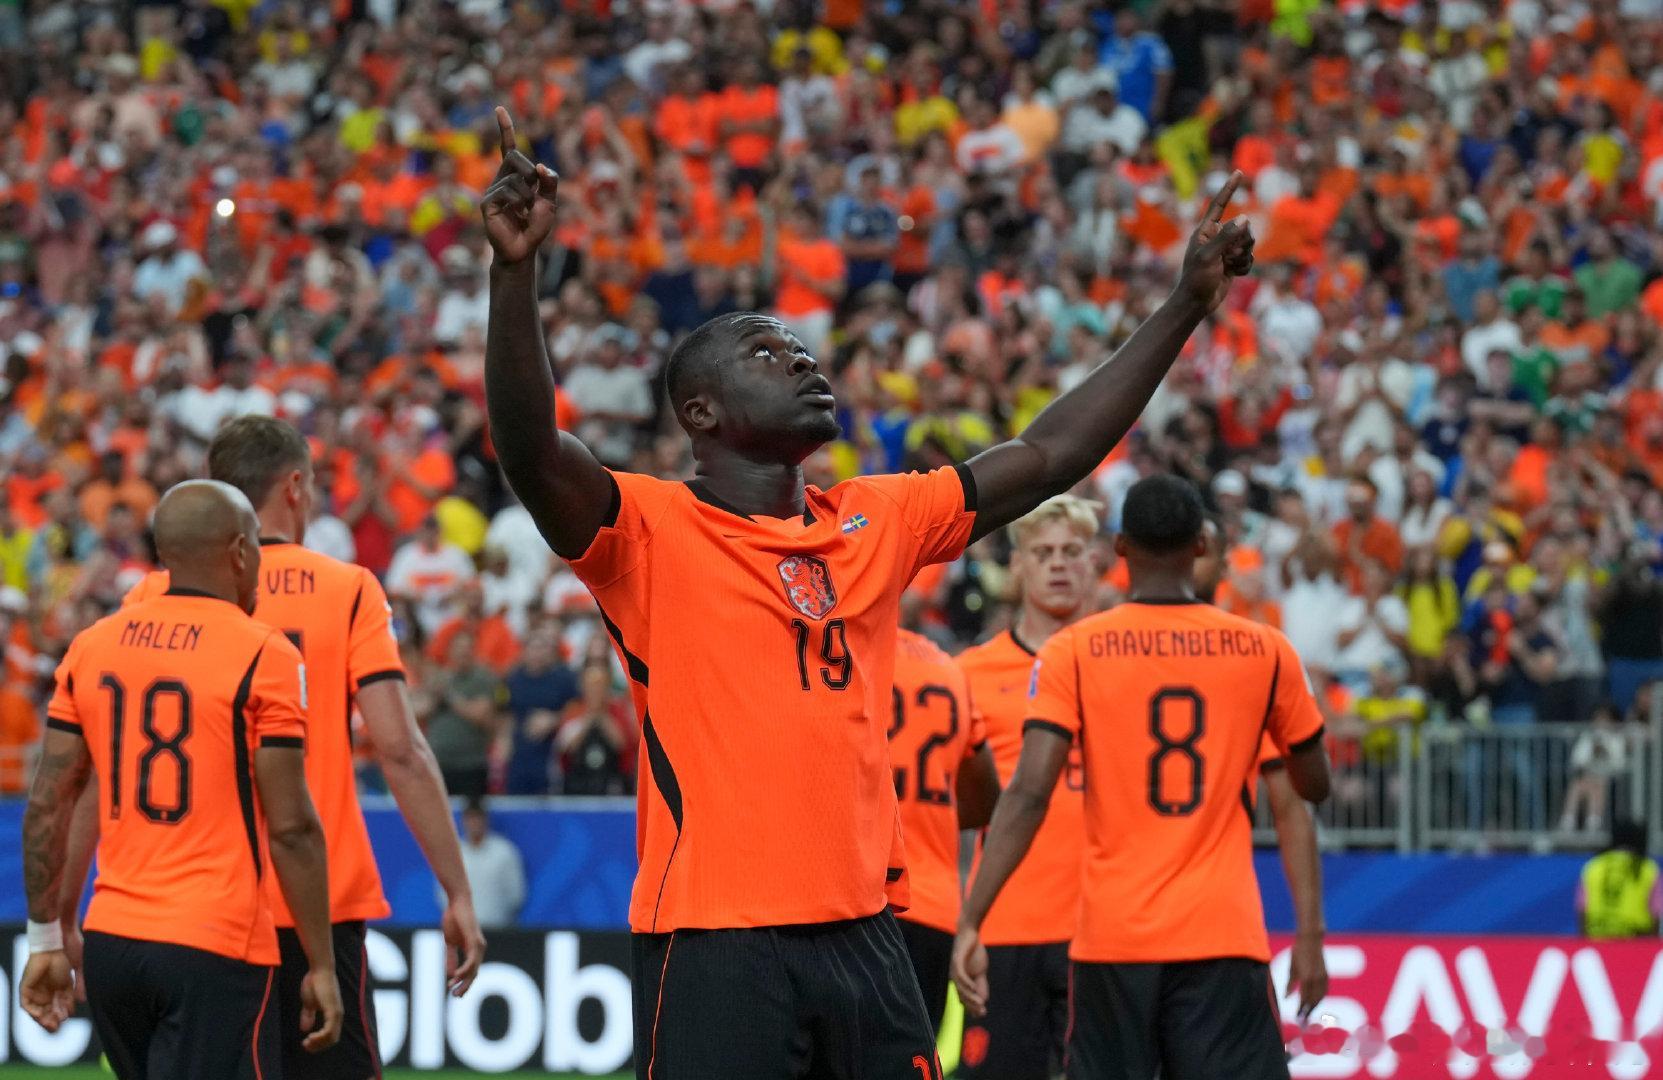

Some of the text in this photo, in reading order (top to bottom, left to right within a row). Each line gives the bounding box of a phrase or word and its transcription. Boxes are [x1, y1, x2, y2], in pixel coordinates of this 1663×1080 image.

[266, 568, 315, 595] VEN
[119, 620, 203, 651] MALEN
[791, 617, 853, 691] 19
[1089, 628, 1266, 658] GRAVENBERCH
[99, 671, 192, 825] 18
[1148, 685, 1207, 817] 8
